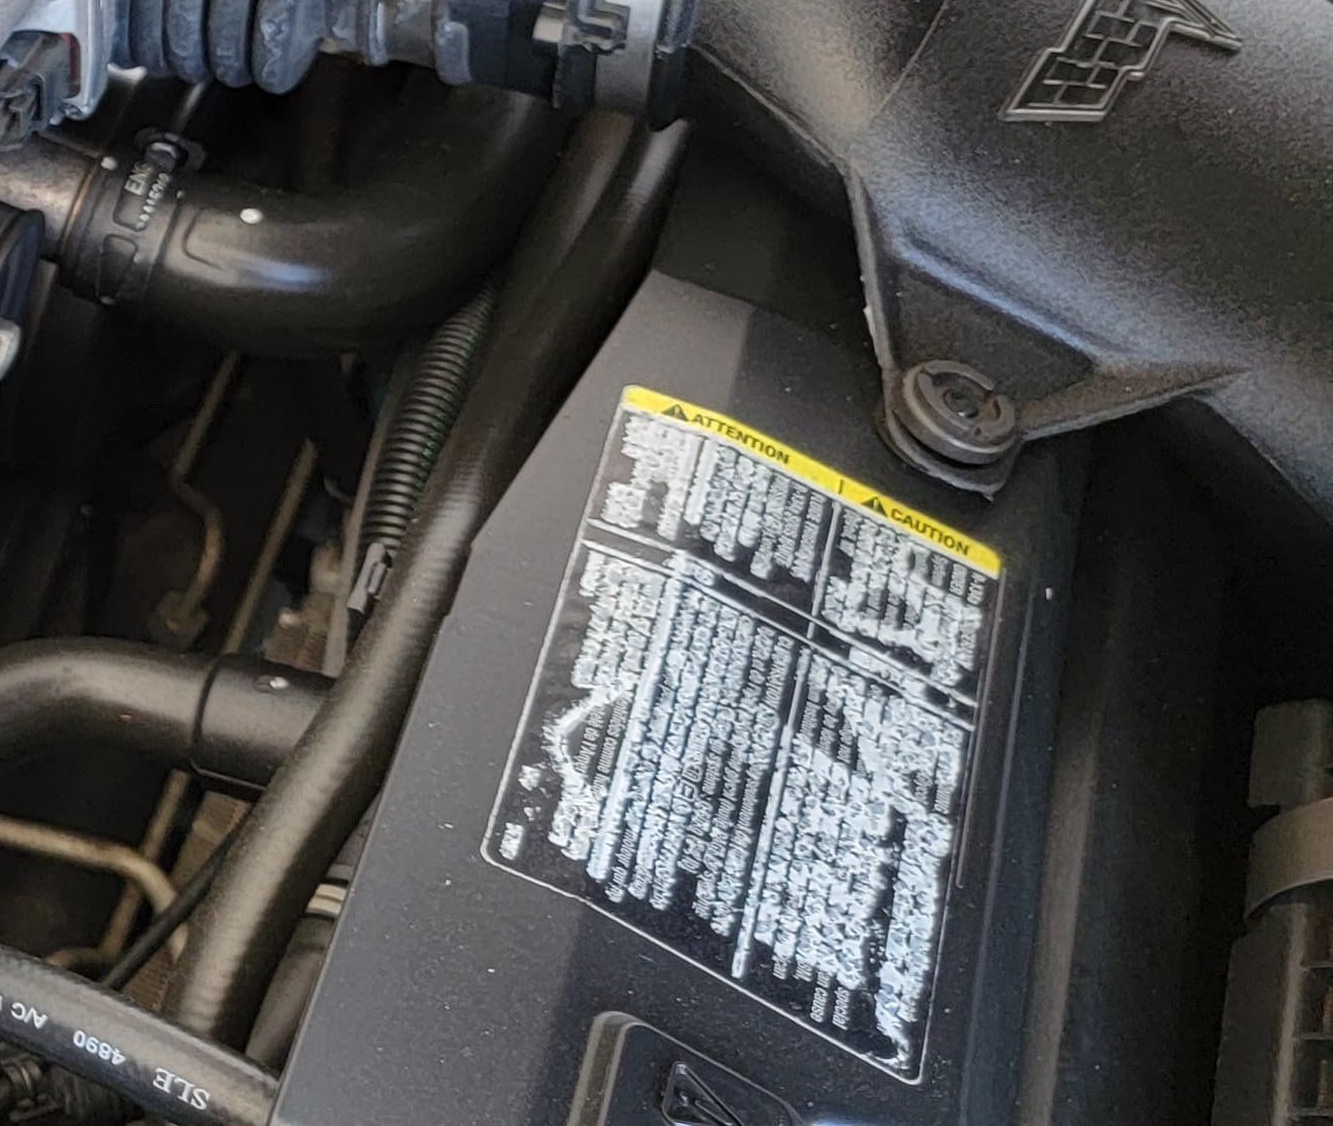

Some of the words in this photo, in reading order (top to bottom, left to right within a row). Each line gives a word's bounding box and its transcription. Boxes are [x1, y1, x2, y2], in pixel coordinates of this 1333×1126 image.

[691, 413, 790, 465] ATTENTION
[890, 507, 970, 557] CAUTION
[596, 734, 618, 775] comme
[10, 1002, 49, 1030] A/C
[808, 985, 828, 1024] cause
[828, 984, 852, 1031] special
[72, 1028, 127, 1066] 4890
[152, 1066, 212, 1110] SLE
